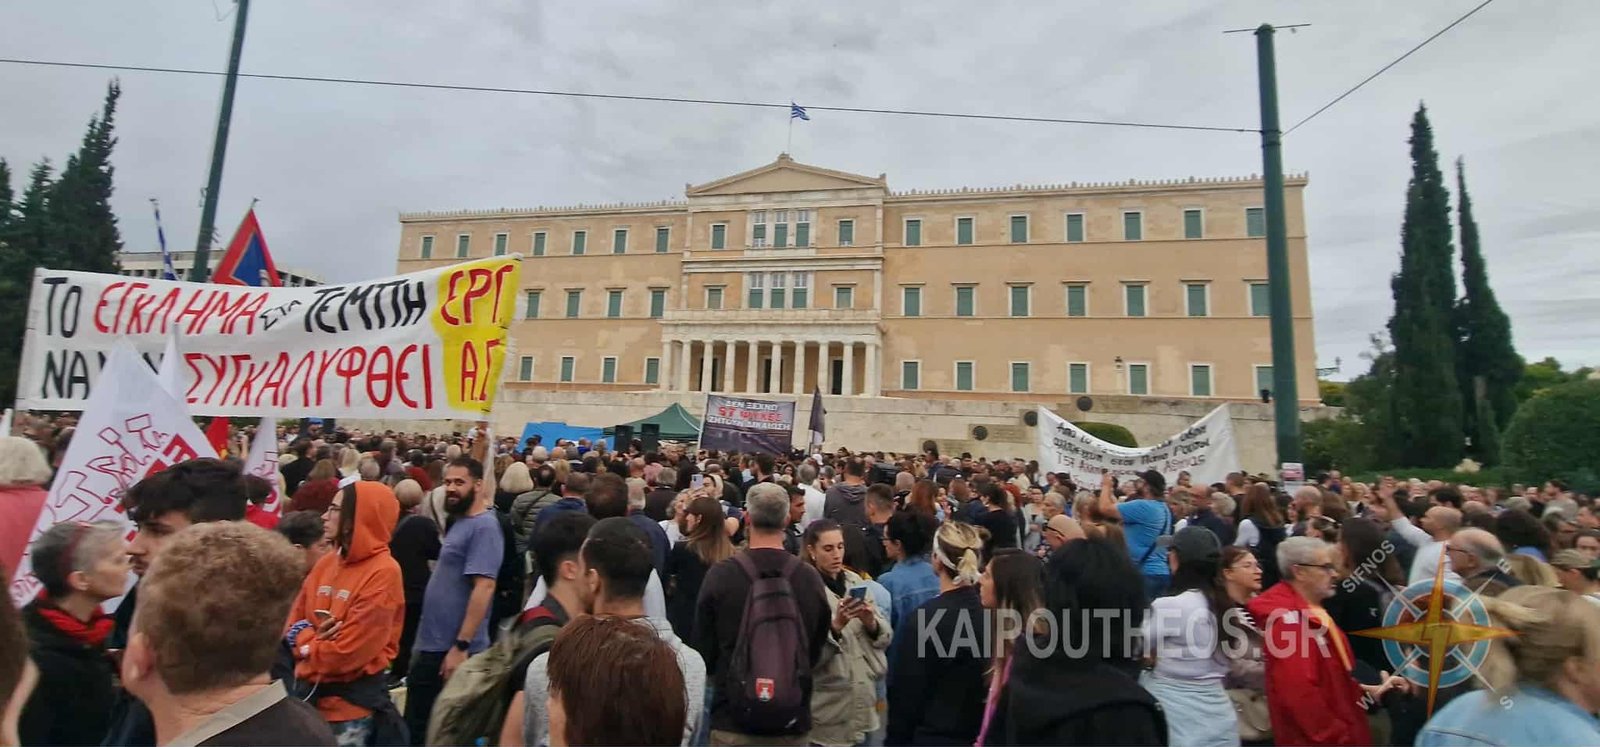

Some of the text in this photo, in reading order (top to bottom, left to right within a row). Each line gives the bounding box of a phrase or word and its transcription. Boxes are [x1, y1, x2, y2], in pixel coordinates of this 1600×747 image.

[42, 276, 82, 338] ΤΟ
[92, 281, 269, 335] ΕΓΚΛΗΜΑ
[304, 279, 427, 333] ΤΕΜΠΗ
[42, 349, 90, 399] ΝΑ
[183, 343, 433, 409] ΣΥΓΚΑΛΥΦΘΕΙ
